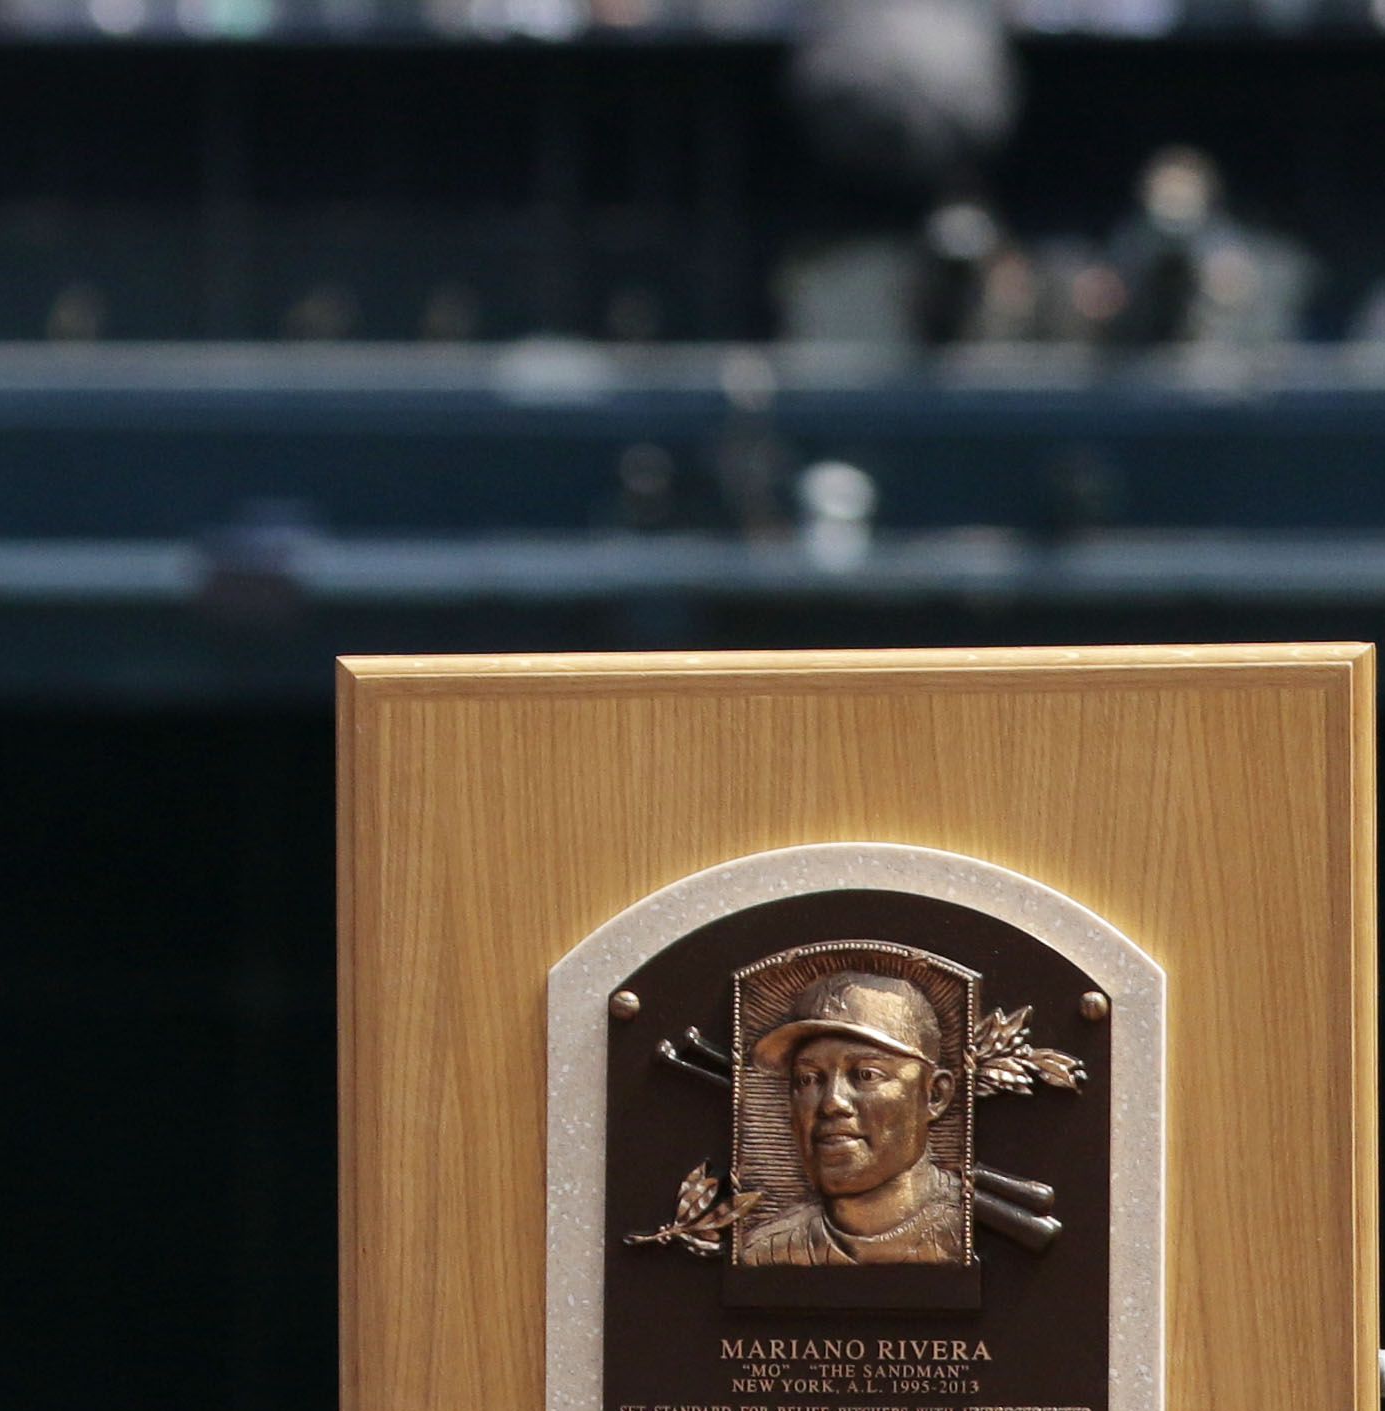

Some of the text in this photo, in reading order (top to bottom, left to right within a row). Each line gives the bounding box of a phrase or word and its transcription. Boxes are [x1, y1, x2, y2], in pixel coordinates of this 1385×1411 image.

[720, 1339, 992, 1361] MARIANO RIVERA
[732, 1379, 980, 1396] NEW YORK, A.L. 1995-2013
